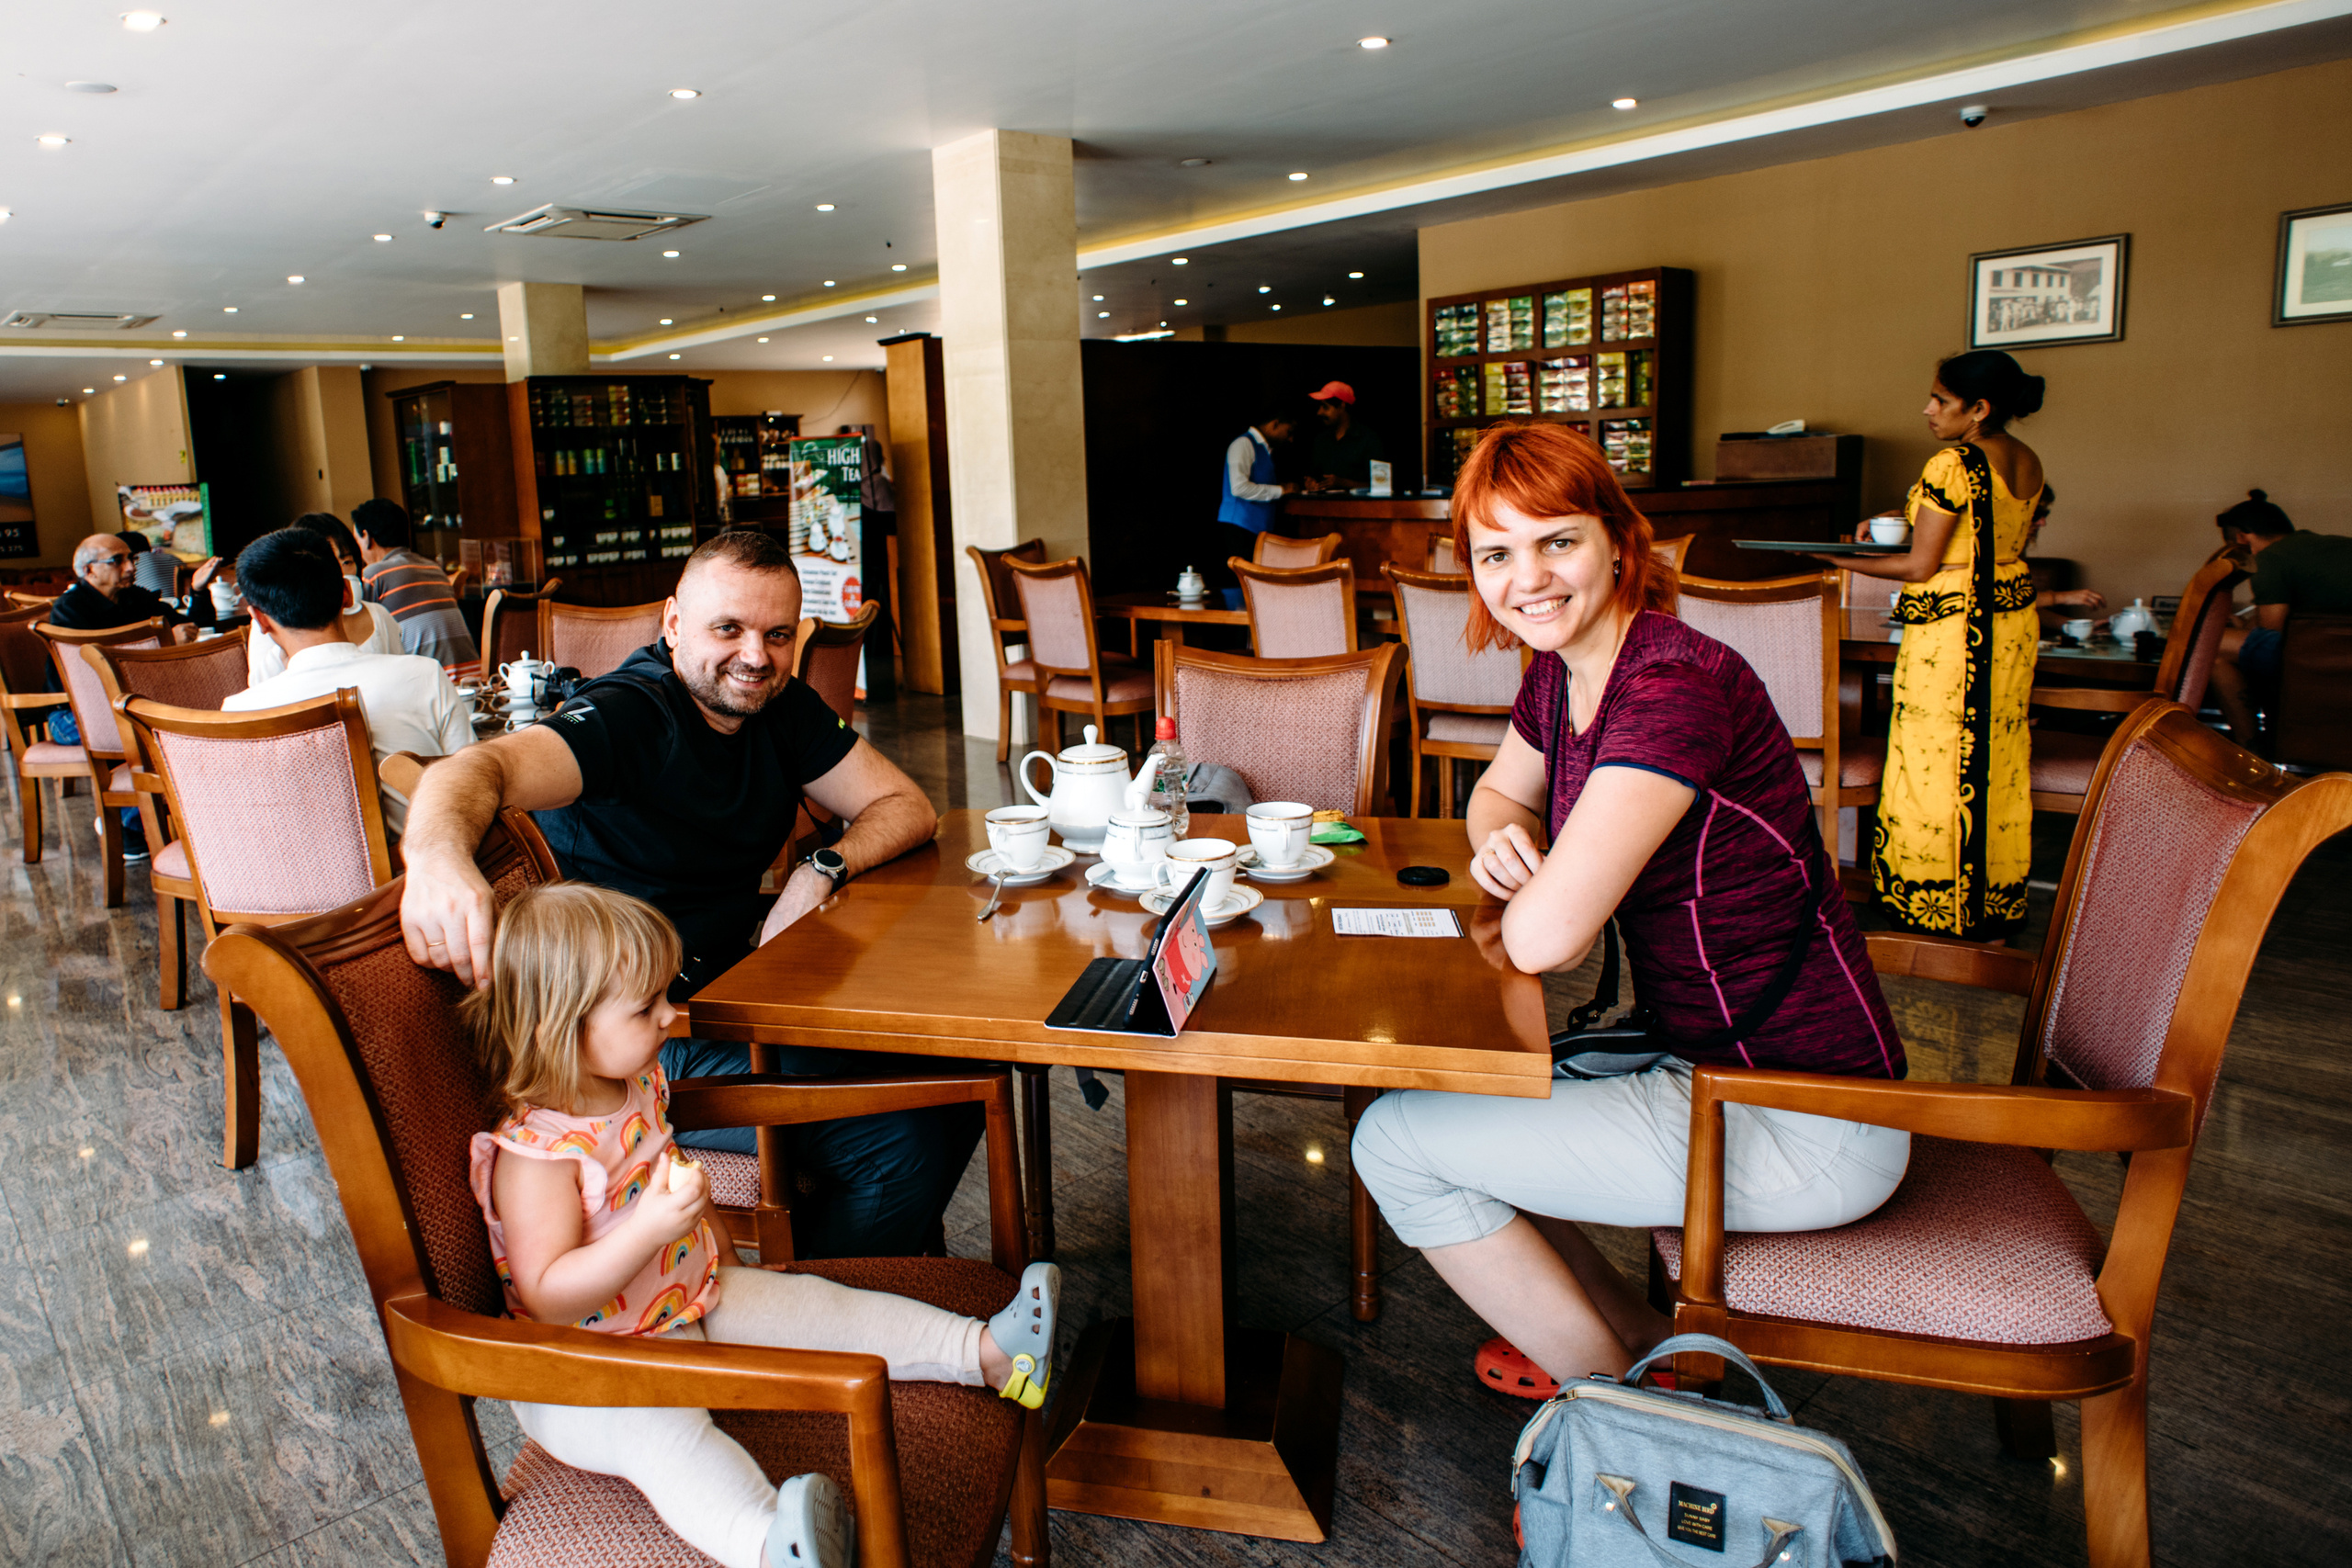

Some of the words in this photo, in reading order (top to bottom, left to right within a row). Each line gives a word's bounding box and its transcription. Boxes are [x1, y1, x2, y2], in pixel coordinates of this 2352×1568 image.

[827, 447, 861, 466] HIGH
[841, 466, 862, 482] TEA
[1679, 1500, 1701, 1511] MACHINE
